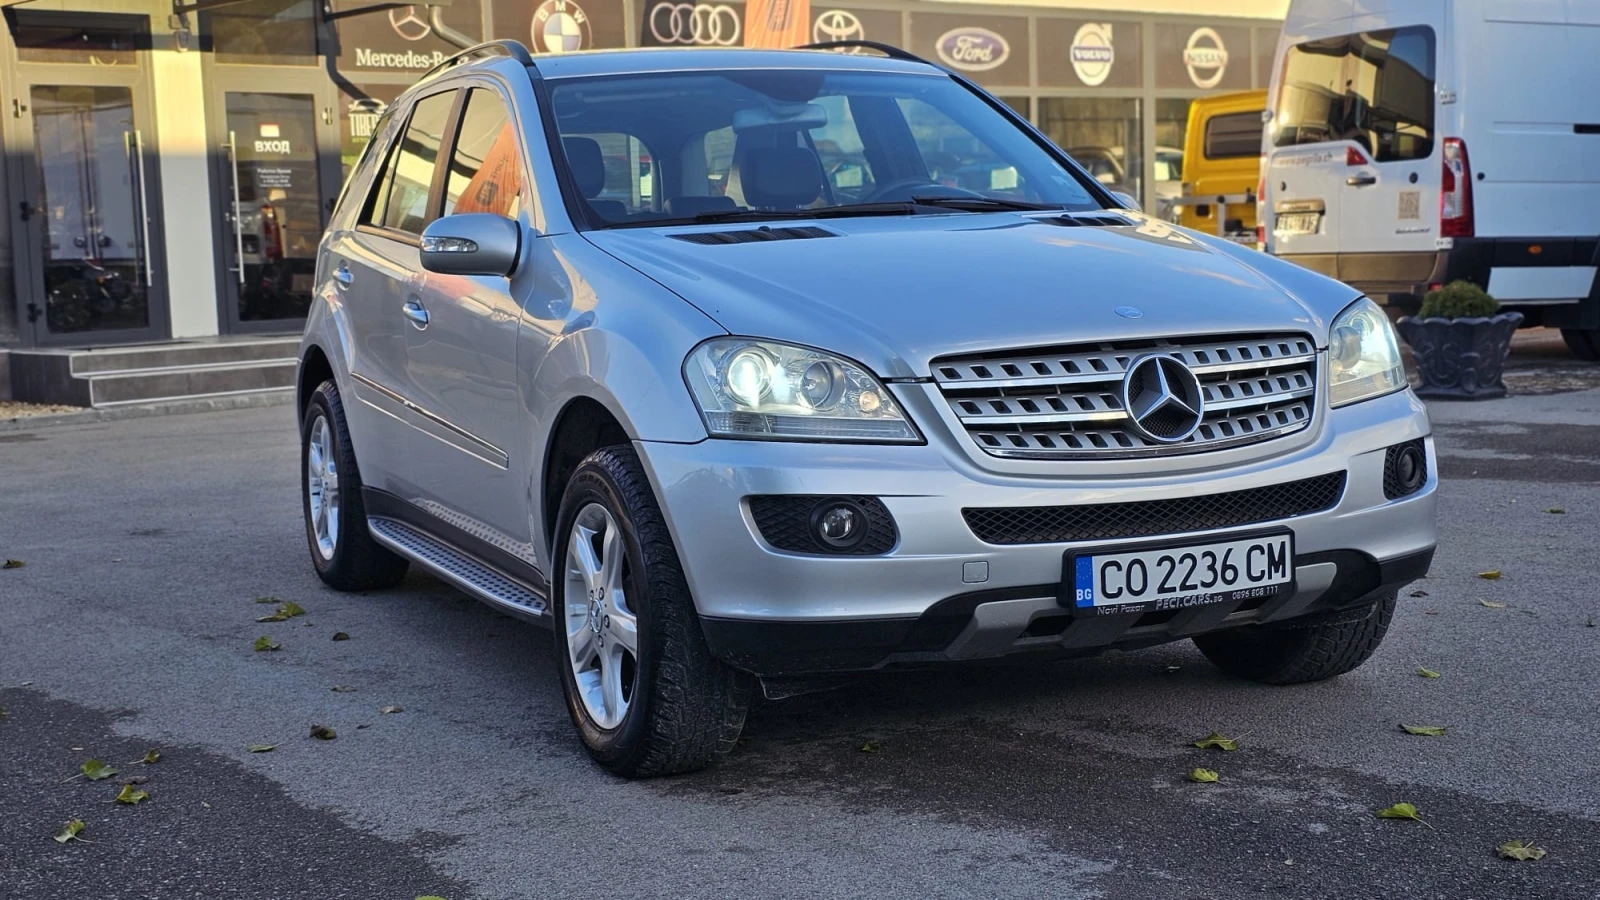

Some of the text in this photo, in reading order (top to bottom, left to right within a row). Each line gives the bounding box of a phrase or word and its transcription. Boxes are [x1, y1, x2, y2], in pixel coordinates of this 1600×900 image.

[538, 0, 586, 24] BMW
[952, 36, 993, 61] Ford
[1075, 50, 1111, 61] VOLVO
[1187, 52, 1224, 64] NISSAN
[254, 140, 291, 155] ВХОД
[1100, 541, 1287, 599] CO 2236 CM
[1076, 588, 1093, 601] BG
[1097, 605, 1119, 616] Novi
[1120, 604, 1146, 614] Pazar
